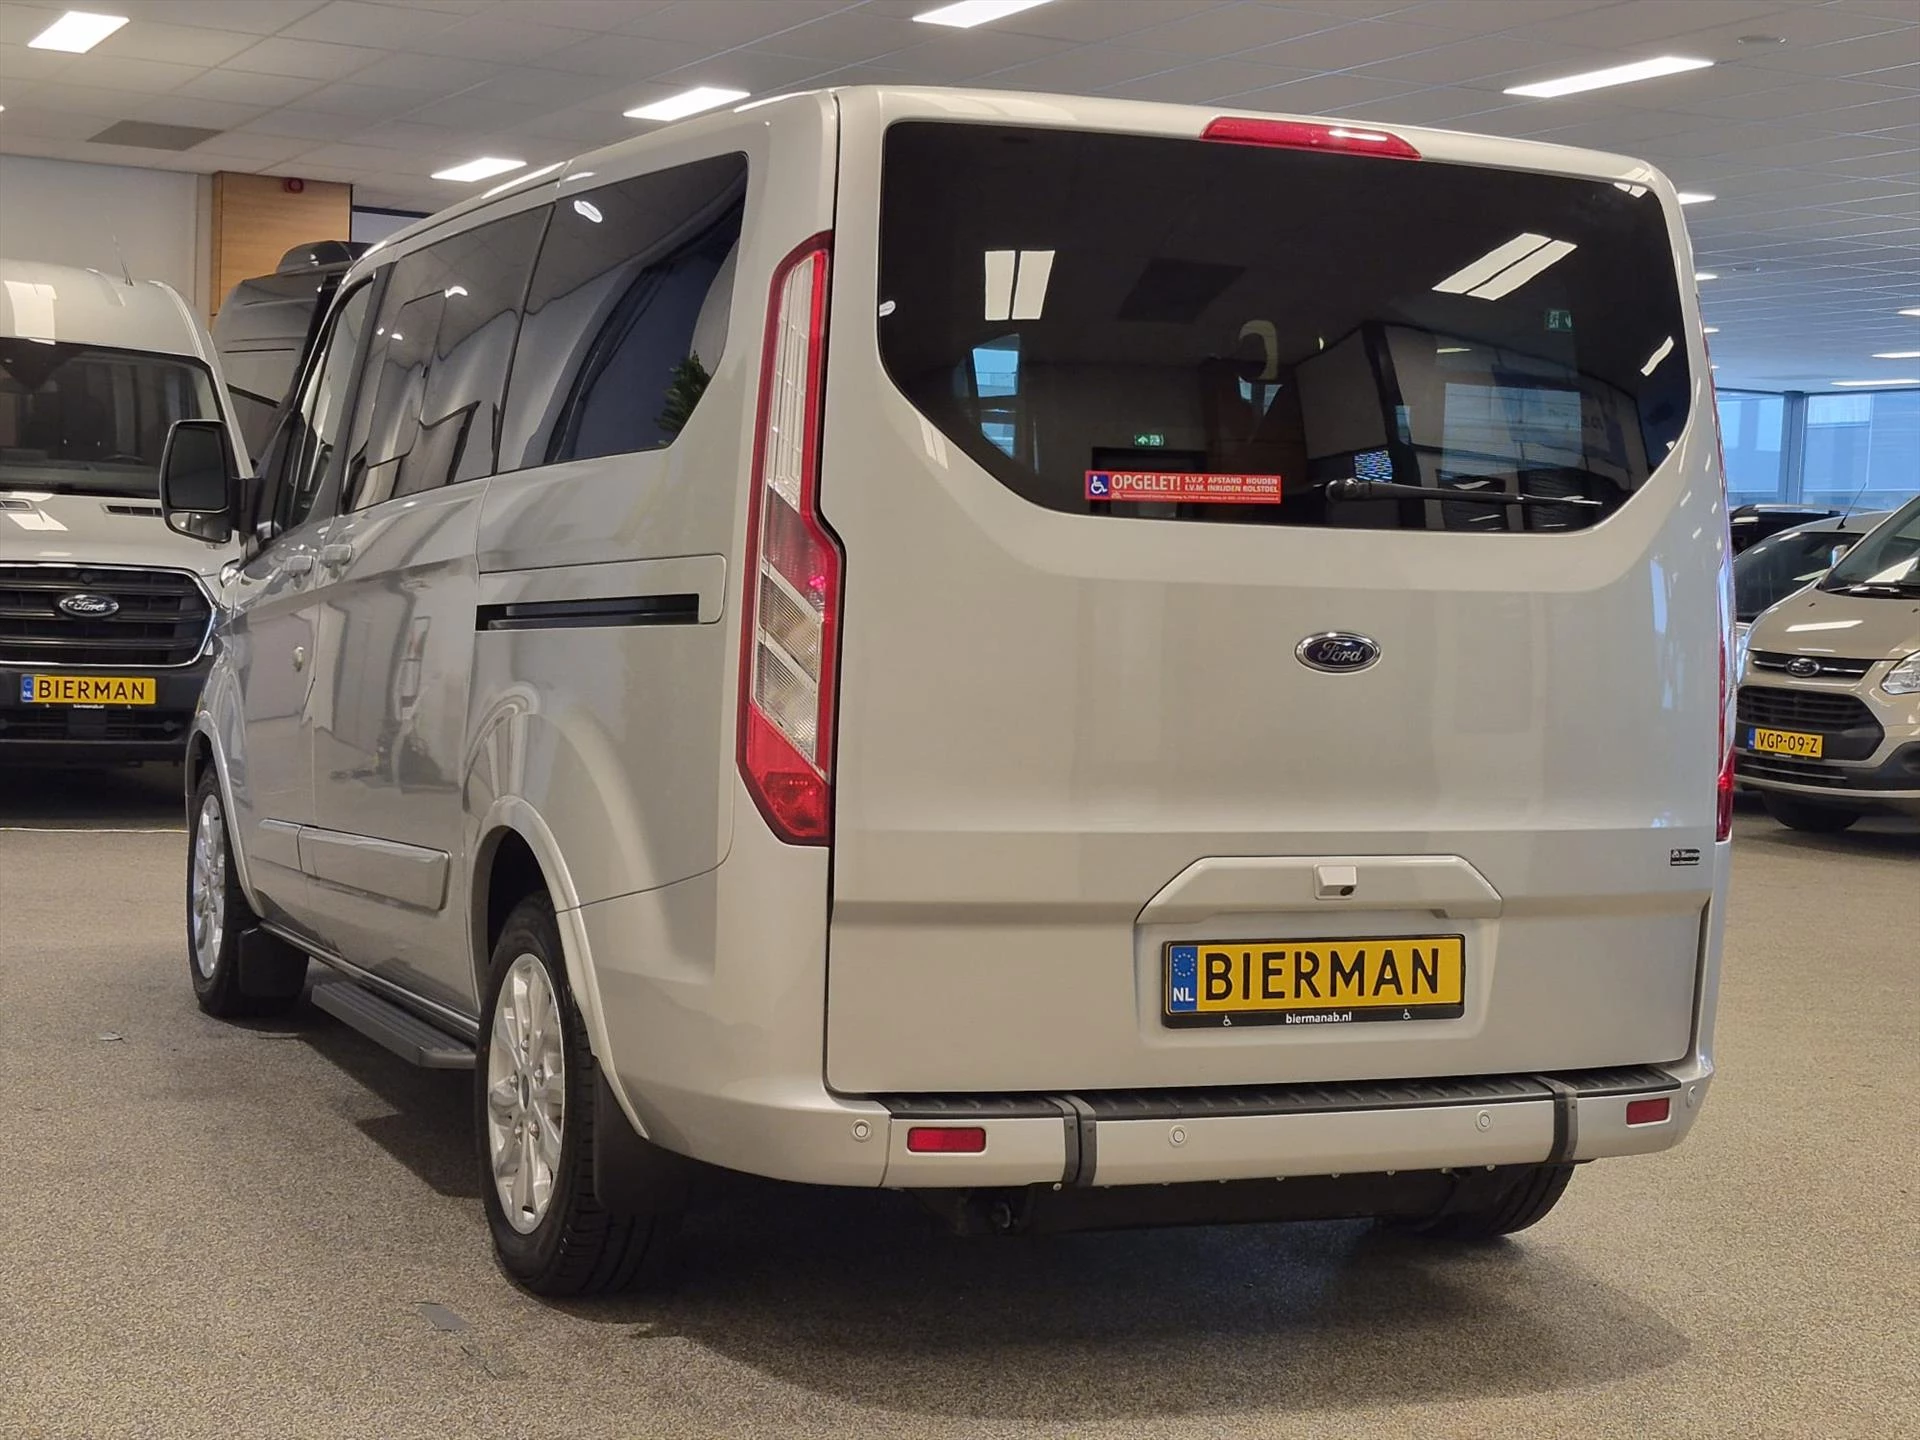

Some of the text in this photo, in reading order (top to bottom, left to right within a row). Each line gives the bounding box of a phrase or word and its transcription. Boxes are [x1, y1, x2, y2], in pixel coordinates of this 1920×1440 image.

[1111, 474, 1181, 491] OPGELET!
[1207, 476, 1242, 485] AFSTAND
[1246, 477, 1278, 486] HOUDEN
[1242, 485, 1279, 494] ROLSTOEL
[1318, 640, 1364, 661] Ford
[39, 680, 145, 700] BIERMAN
[1759, 732, 1818, 753] VGP-09-Z
[1204, 948, 1440, 1001] BIERMAN
[1172, 987, 1194, 1002] NL
[1285, 1011, 1352, 1024] biermanab.nl
